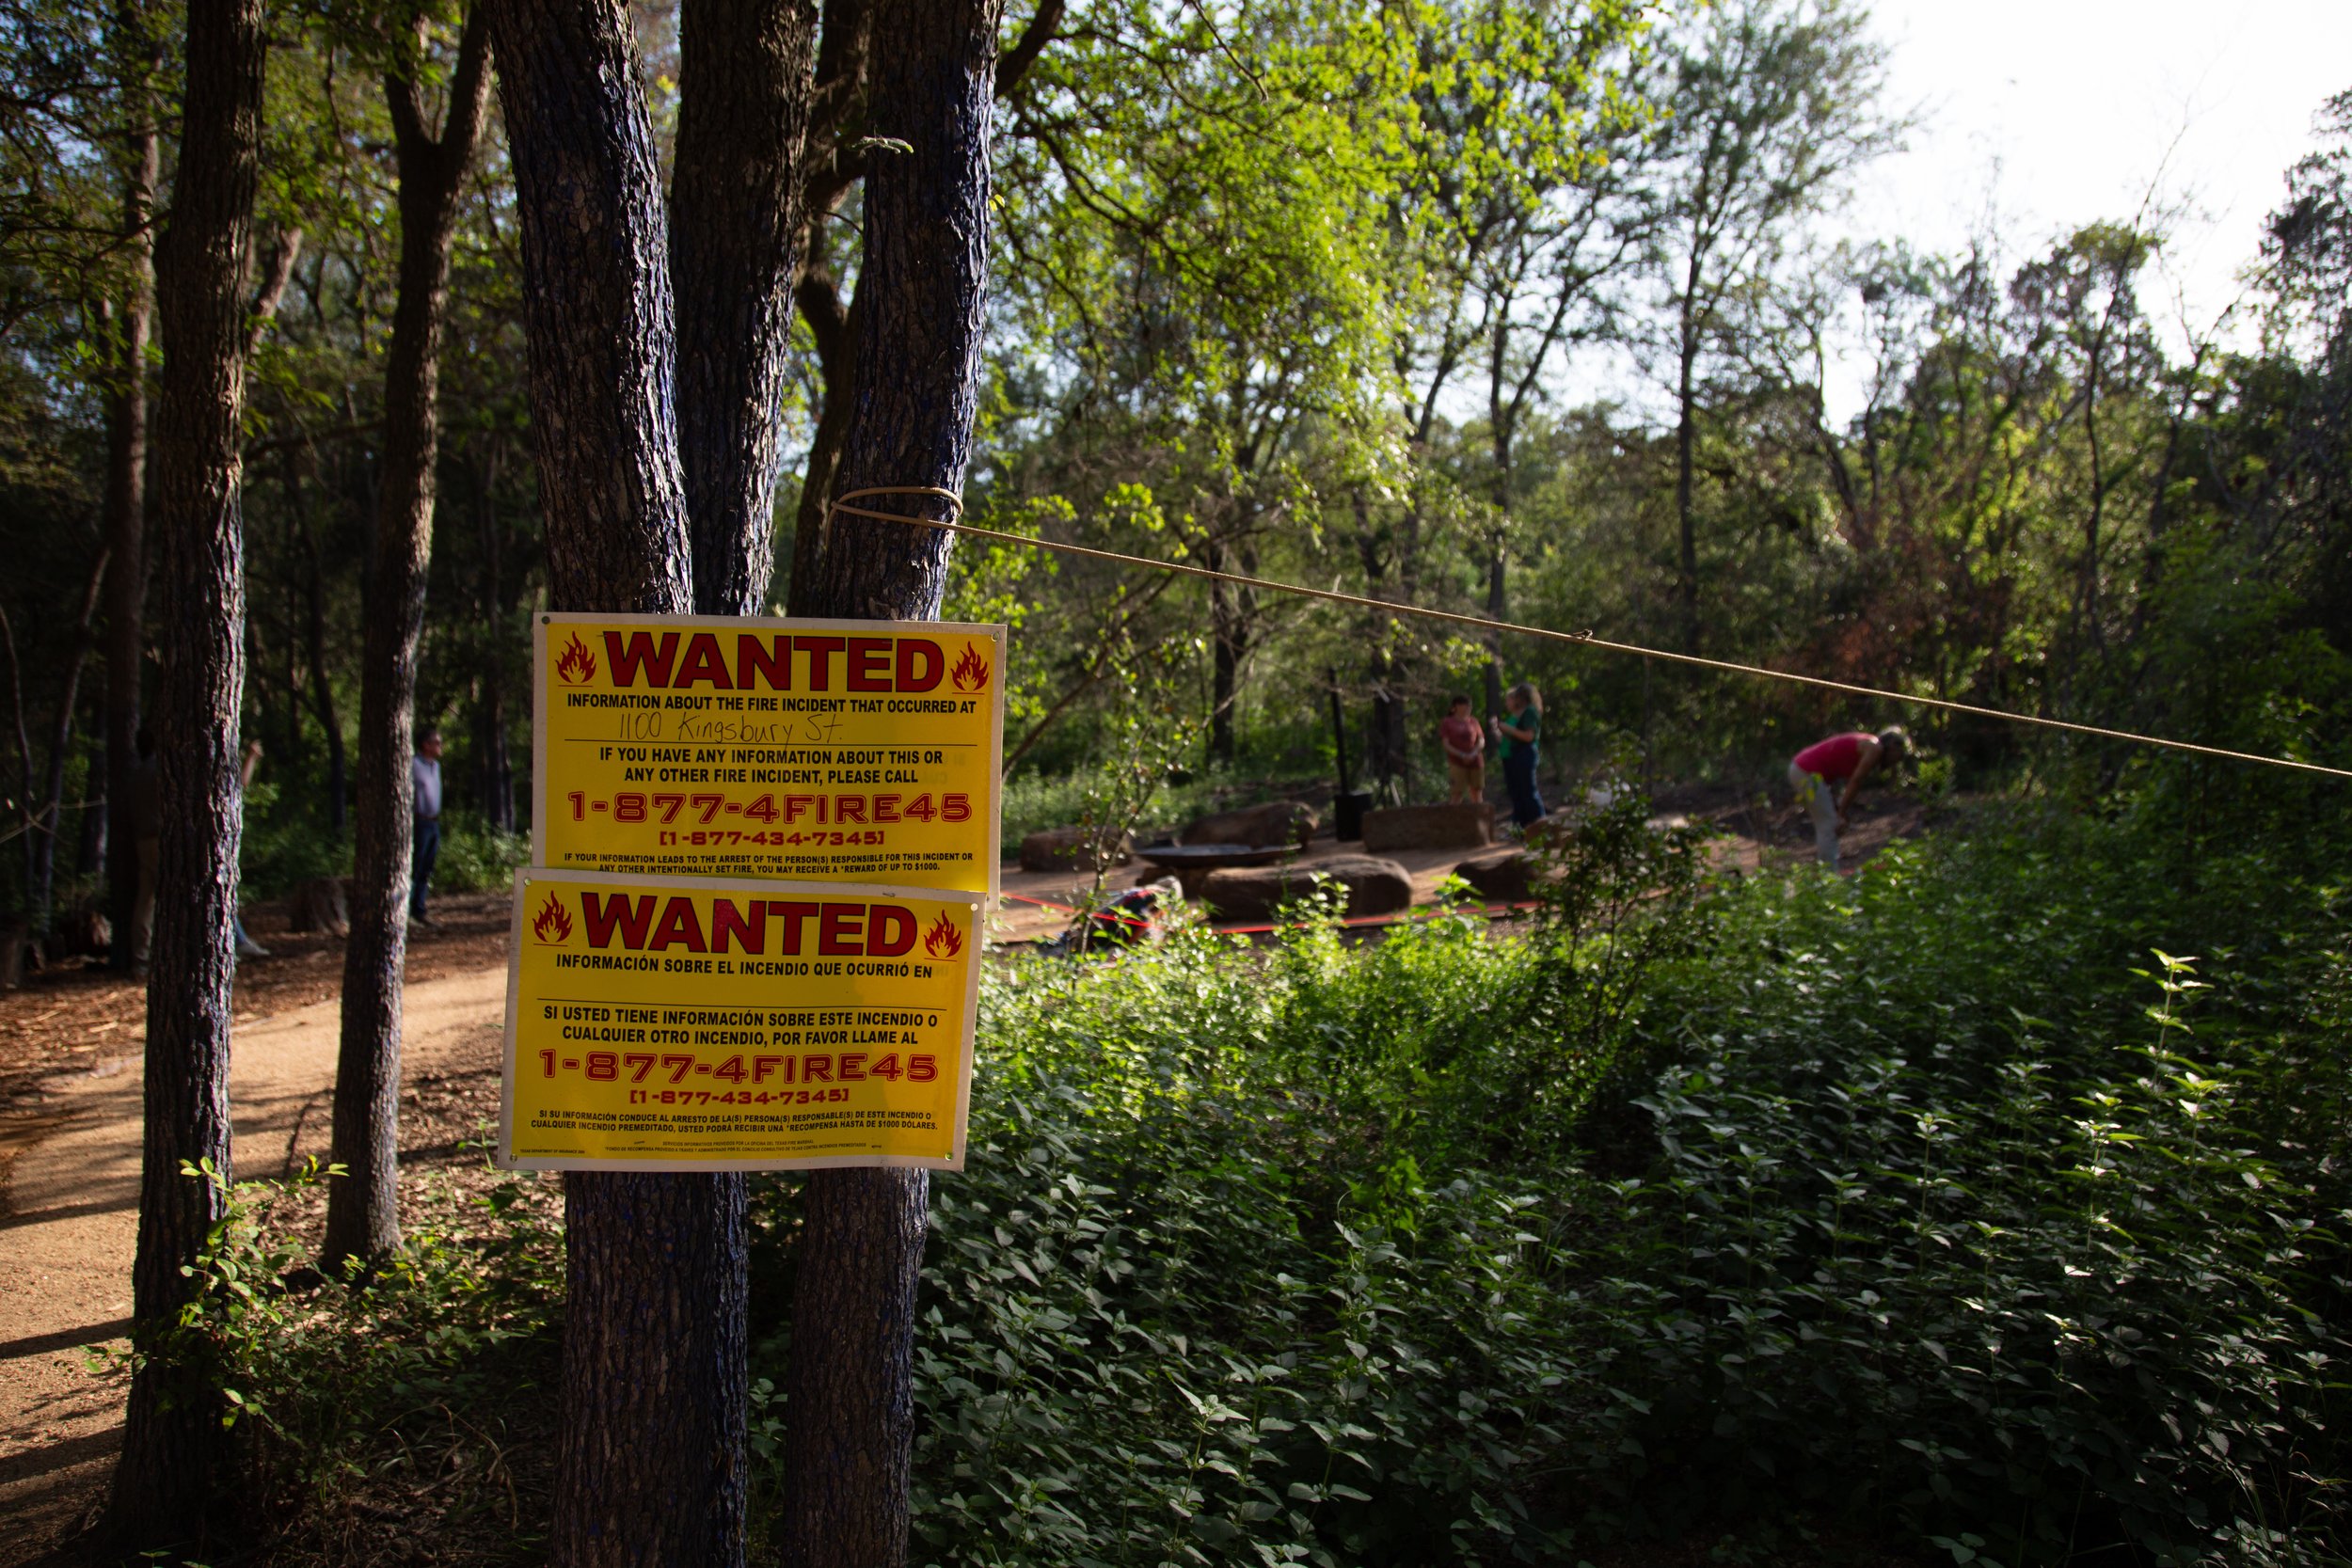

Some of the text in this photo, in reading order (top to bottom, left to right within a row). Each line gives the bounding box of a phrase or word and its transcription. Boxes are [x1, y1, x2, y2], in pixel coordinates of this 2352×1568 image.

[603, 631, 945, 693] WANTED
[568, 693, 977, 714] INFORMATION ABOUT THE FIRE INCIDENT THAT OCCURRED AT
[619, 712, 662, 739] 1100
[677, 710, 793, 751] Kingsbury
[600, 747, 943, 765] IF YOU HAVE ANY INFORMATION ABOUT THIS OR
[625, 768, 918, 786] ANY OTHER FIRE INCIDENT, PLEASE CALL
[567, 791, 972, 825] 1-877-4FIRE45
[575, 853, 596, 862] YOUR
[599, 854, 655, 863] INFORMATION
[658, 855, 684, 863] LEADS
[687, 855, 698, 863] TO
[700, 855, 716, 863] THE
[767, 855, 783, 863] THE
[786, 856, 828, 865] PERSON(S)
[831, 854, 883, 863] RESPONSIBLE
[885, 853, 900, 862] FOR
[961, 852, 973, 861] OR
[598, 864, 615, 873] ANY
[618, 864, 645, 873] OTHER
[647, 865, 713, 874] INTENTIONALLY
[734, 865, 755, 874] FIRE,
[796, 865, 830, 874] RECEIVE
[878, 863, 888, 872] OF
[902, 863, 913, 871] TO
[914, 863, 940, 871] $1000.
[580, 892, 917, 957] WANTED
[557, 954, 932, 978] INFORMACIÓN SOBRE EL INCENDIO QUE OCURRIÓ EN
[544, 1006, 937, 1027] SI USTED TIENE INFORMACIÓN SOBRE ESTE INCENDIO O
[563, 1025, 918, 1048] CUALQUIER OTRO INCENDIO, POR FAVOR LLAME AL
[539, 1049, 938, 1085] 1-877-4FIRE45
[532, 1119, 576, 1129] CUALQUIER
[579, 1122, 616, 1132] INCENDIO
[618, 1123, 675, 1132] PREMEDITADO,
[549, 1110, 560, 1118] SU
[671, 1115, 707, 1123] ARRESTO
[723, 1115, 741, 1123] LA(S)
[744, 1115, 790, 1124] PERSONA(S)
[792, 1111, 853, 1122] RESPONSABLE(S)
[888, 1111, 924, 1119] INCENDIO
